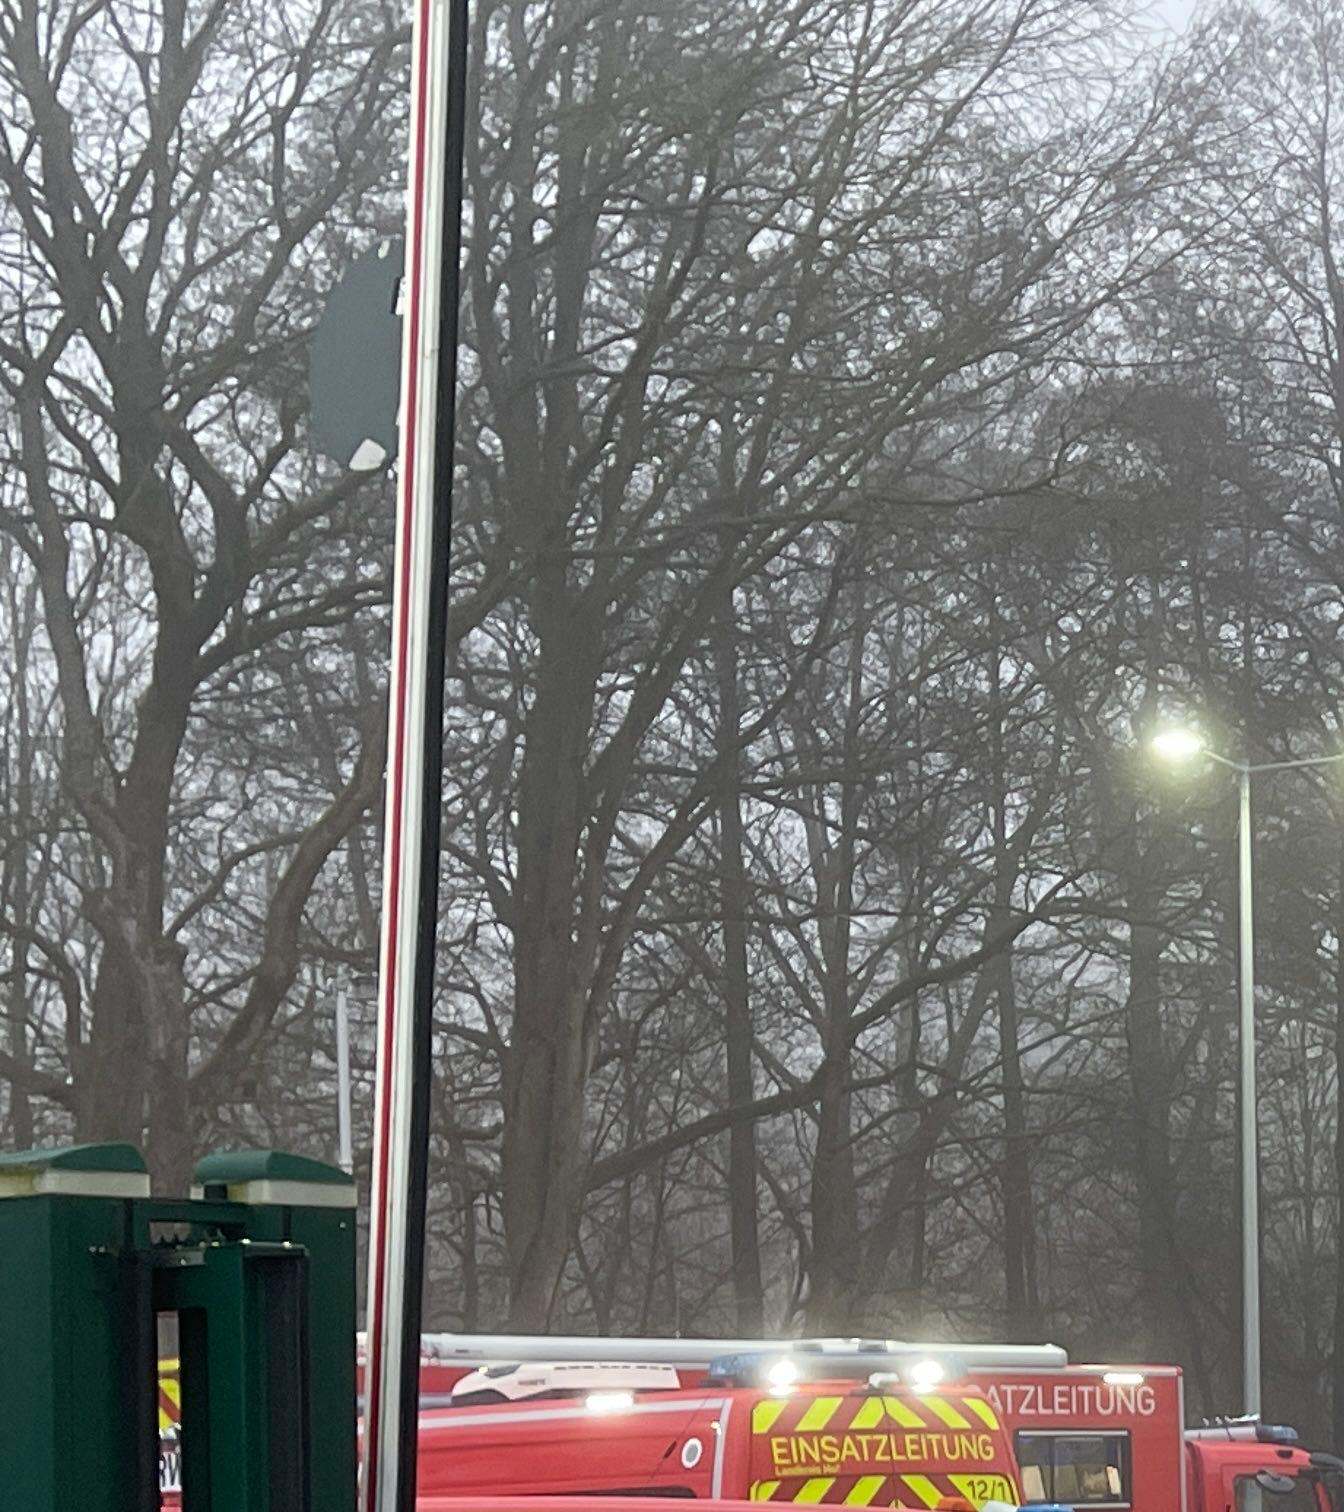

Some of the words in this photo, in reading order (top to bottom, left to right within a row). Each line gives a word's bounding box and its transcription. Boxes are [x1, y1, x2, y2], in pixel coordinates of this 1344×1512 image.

[984, 1384, 1156, 1415] ATZLEITUNG
[770, 1433, 996, 1465] EINSATZLEITUNG
[966, 1479, 1007, 1503] 12/1
